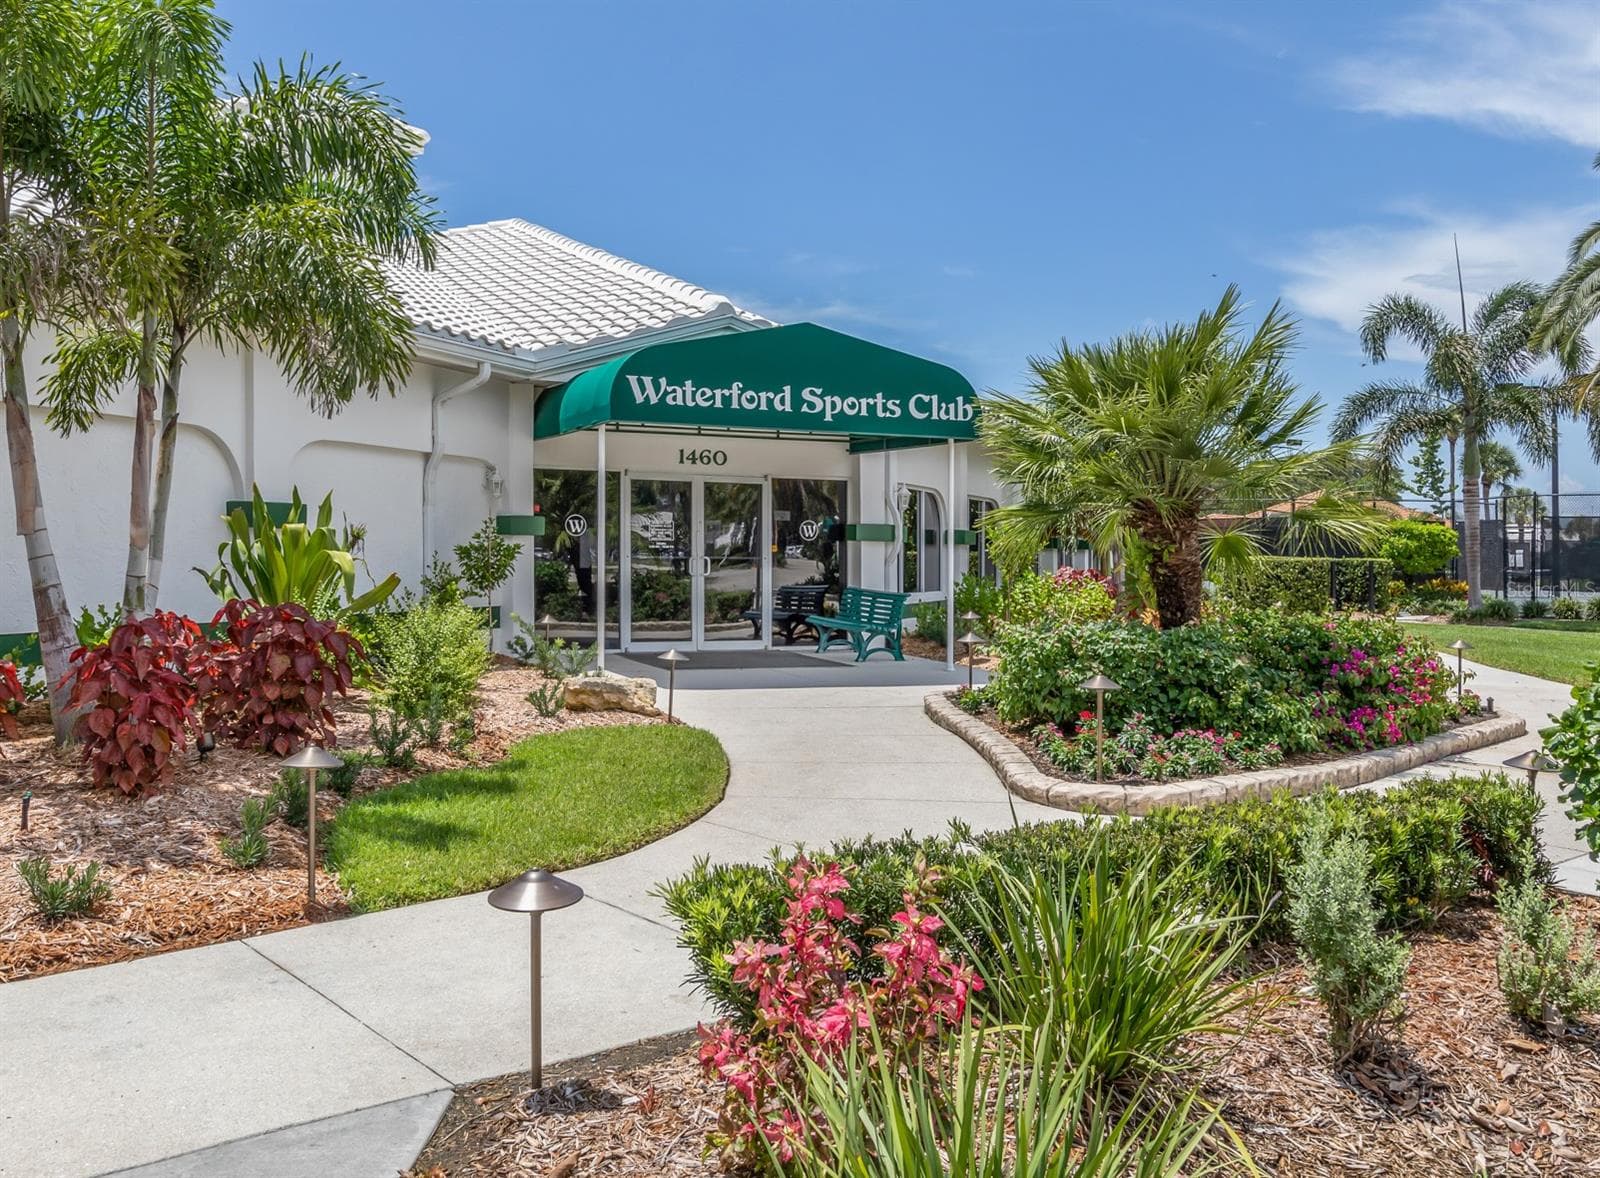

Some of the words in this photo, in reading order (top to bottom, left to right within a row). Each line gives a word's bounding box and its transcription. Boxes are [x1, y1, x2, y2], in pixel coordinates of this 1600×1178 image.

[626, 375, 793, 412] Waterford
[800, 387, 901, 421] Sports
[908, 393, 973, 421] Club
[678, 449, 728, 466] 1460
